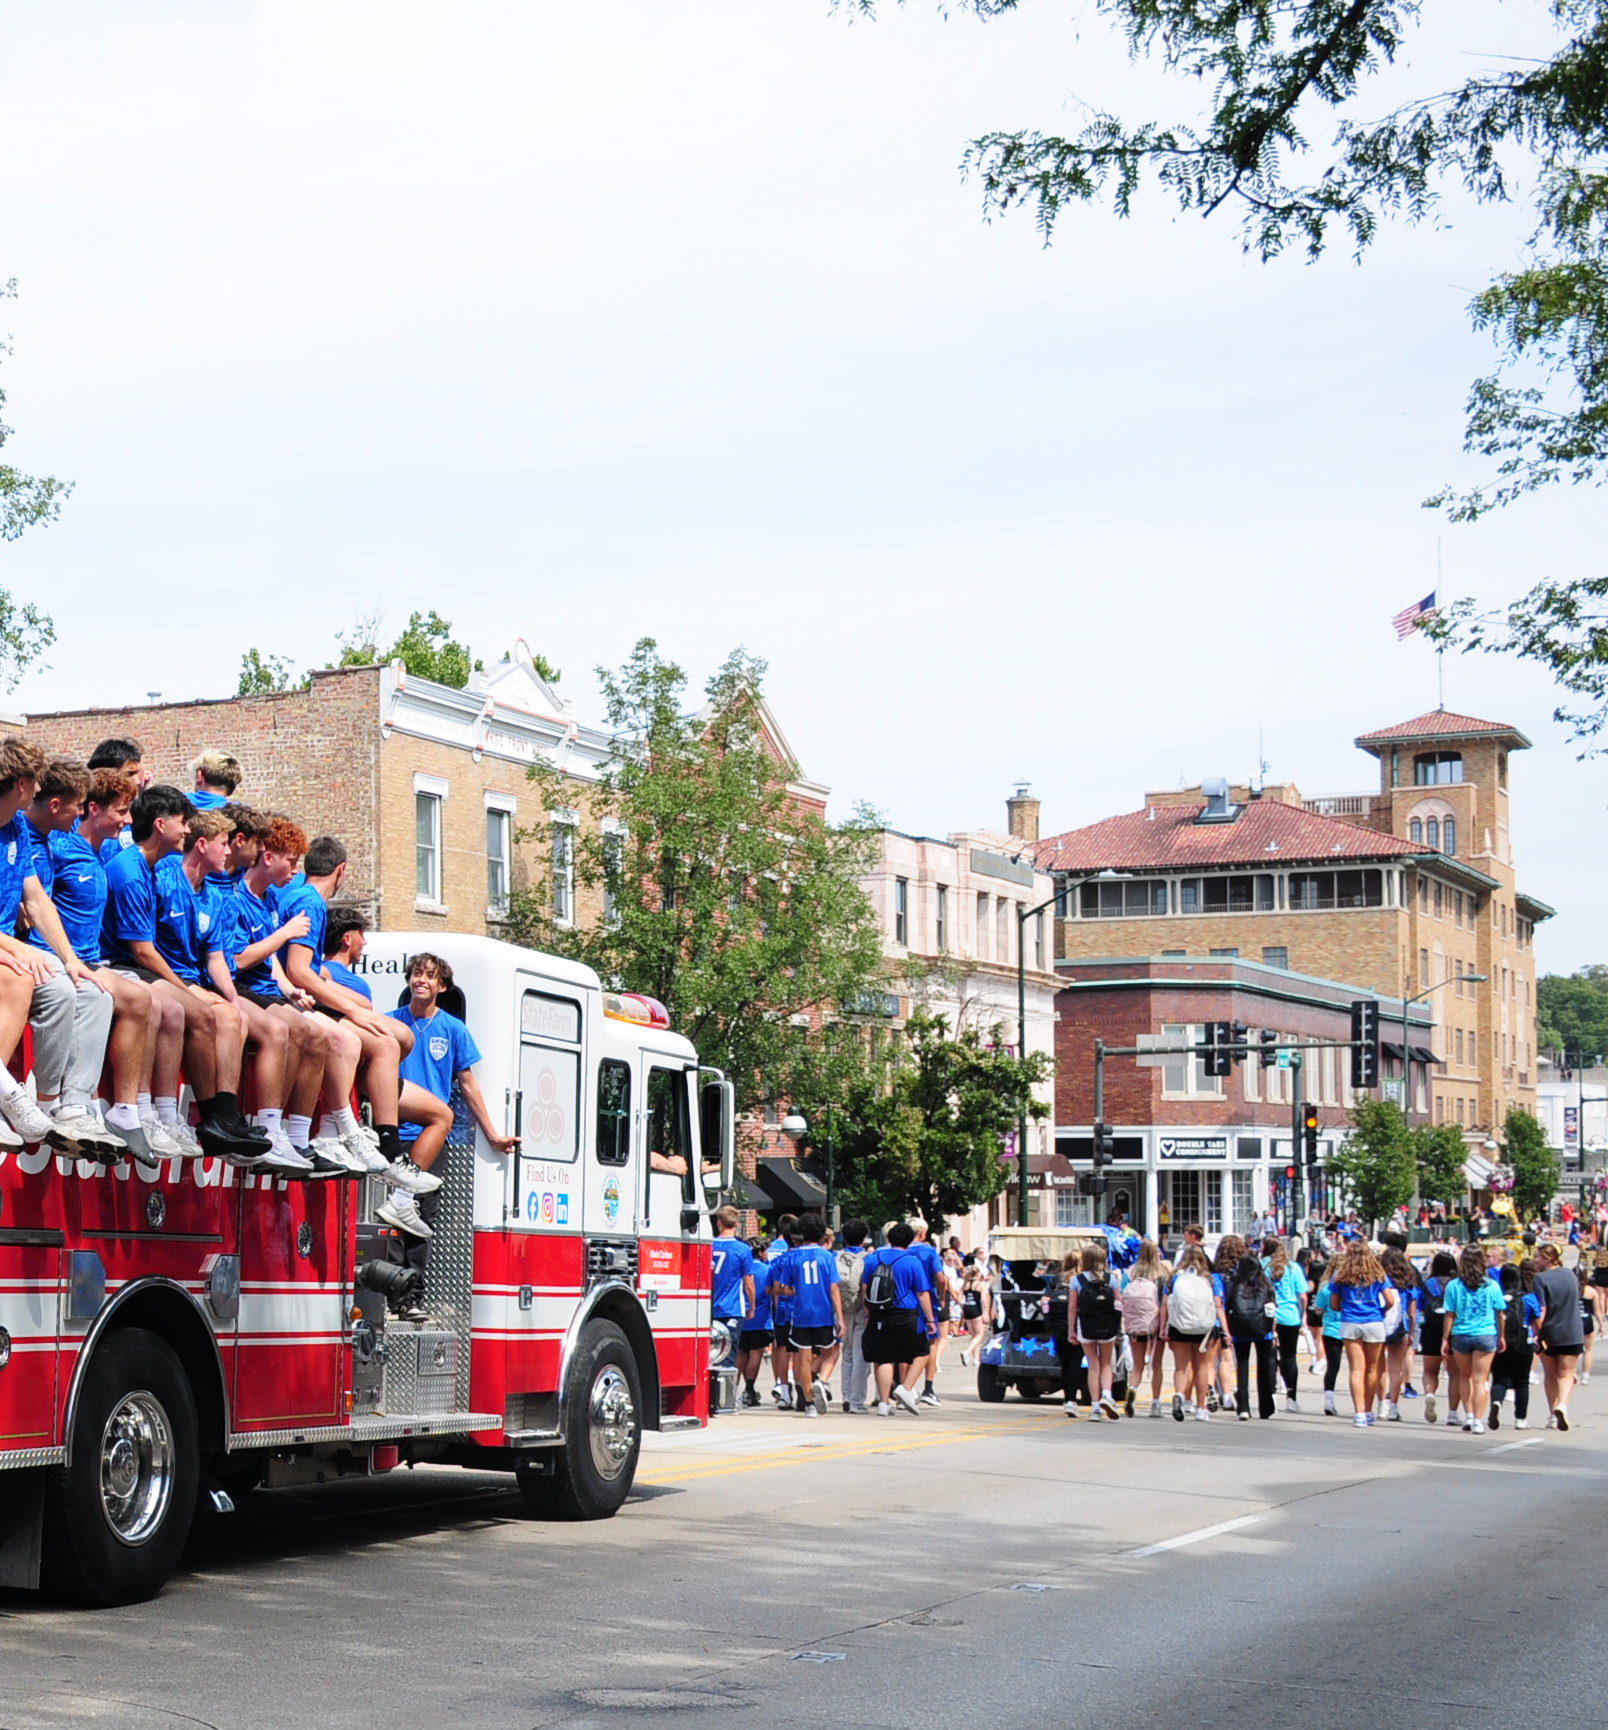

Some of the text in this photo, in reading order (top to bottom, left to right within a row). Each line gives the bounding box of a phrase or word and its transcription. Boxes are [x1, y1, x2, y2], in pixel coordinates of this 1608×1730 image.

[526, 1164, 569, 1185] Find Us On
[802, 1260, 819, 1285] 11
